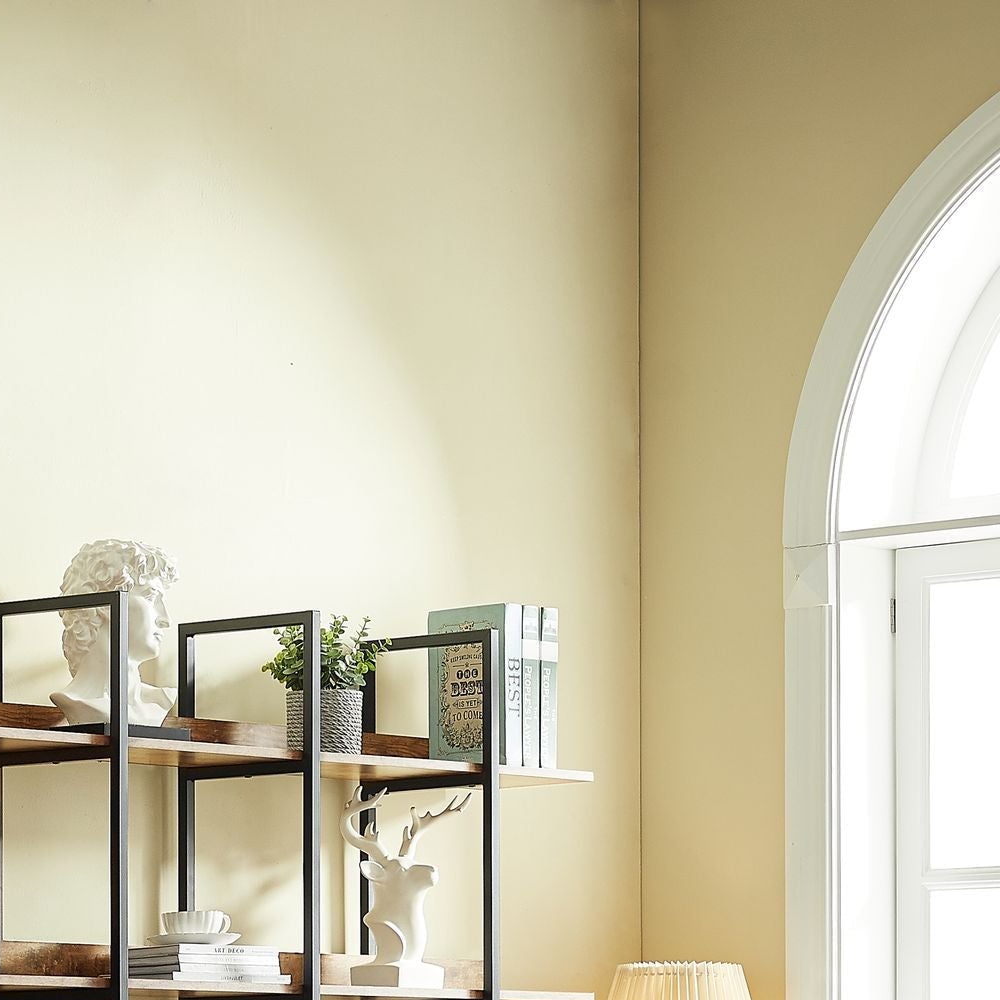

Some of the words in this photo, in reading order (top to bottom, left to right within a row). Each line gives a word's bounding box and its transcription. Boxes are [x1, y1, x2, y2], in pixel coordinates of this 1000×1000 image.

[456, 668, 478, 679] THE
[450, 680, 483, 697] BEST
[508, 658, 521, 718] BEST
[524, 666, 533, 715] PEOPLE'S
[452, 712, 462, 721] TO
[463, 709, 483, 720] COME
